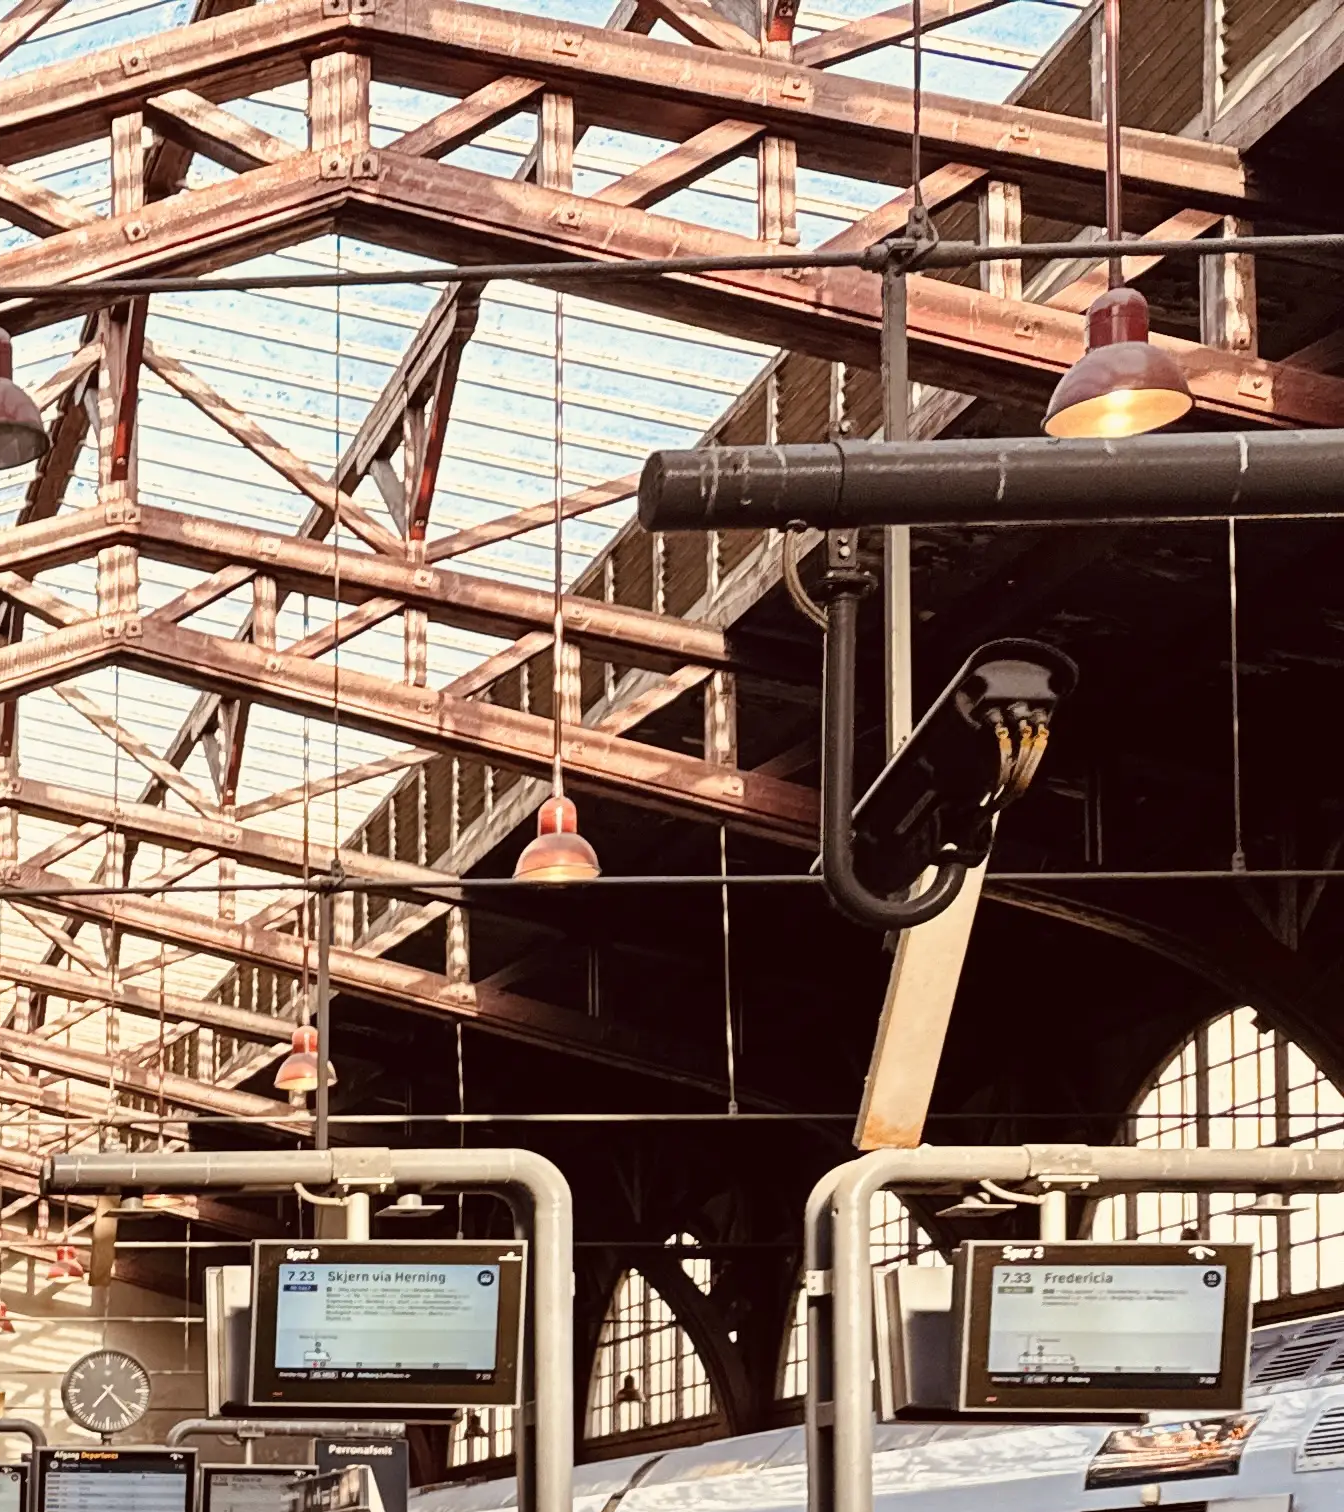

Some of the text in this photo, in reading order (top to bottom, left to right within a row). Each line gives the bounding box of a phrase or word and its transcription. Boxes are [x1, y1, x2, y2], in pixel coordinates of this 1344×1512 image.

[1002, 1246, 1044, 1261] Spor 2
[327, 1271, 447, 1285] Skjern via Herning
[1002, 1272, 1031, 1284] 7.33
[1044, 1272, 1114, 1285] Fredericia
[328, 1444, 393, 1456] Perronafsnit
